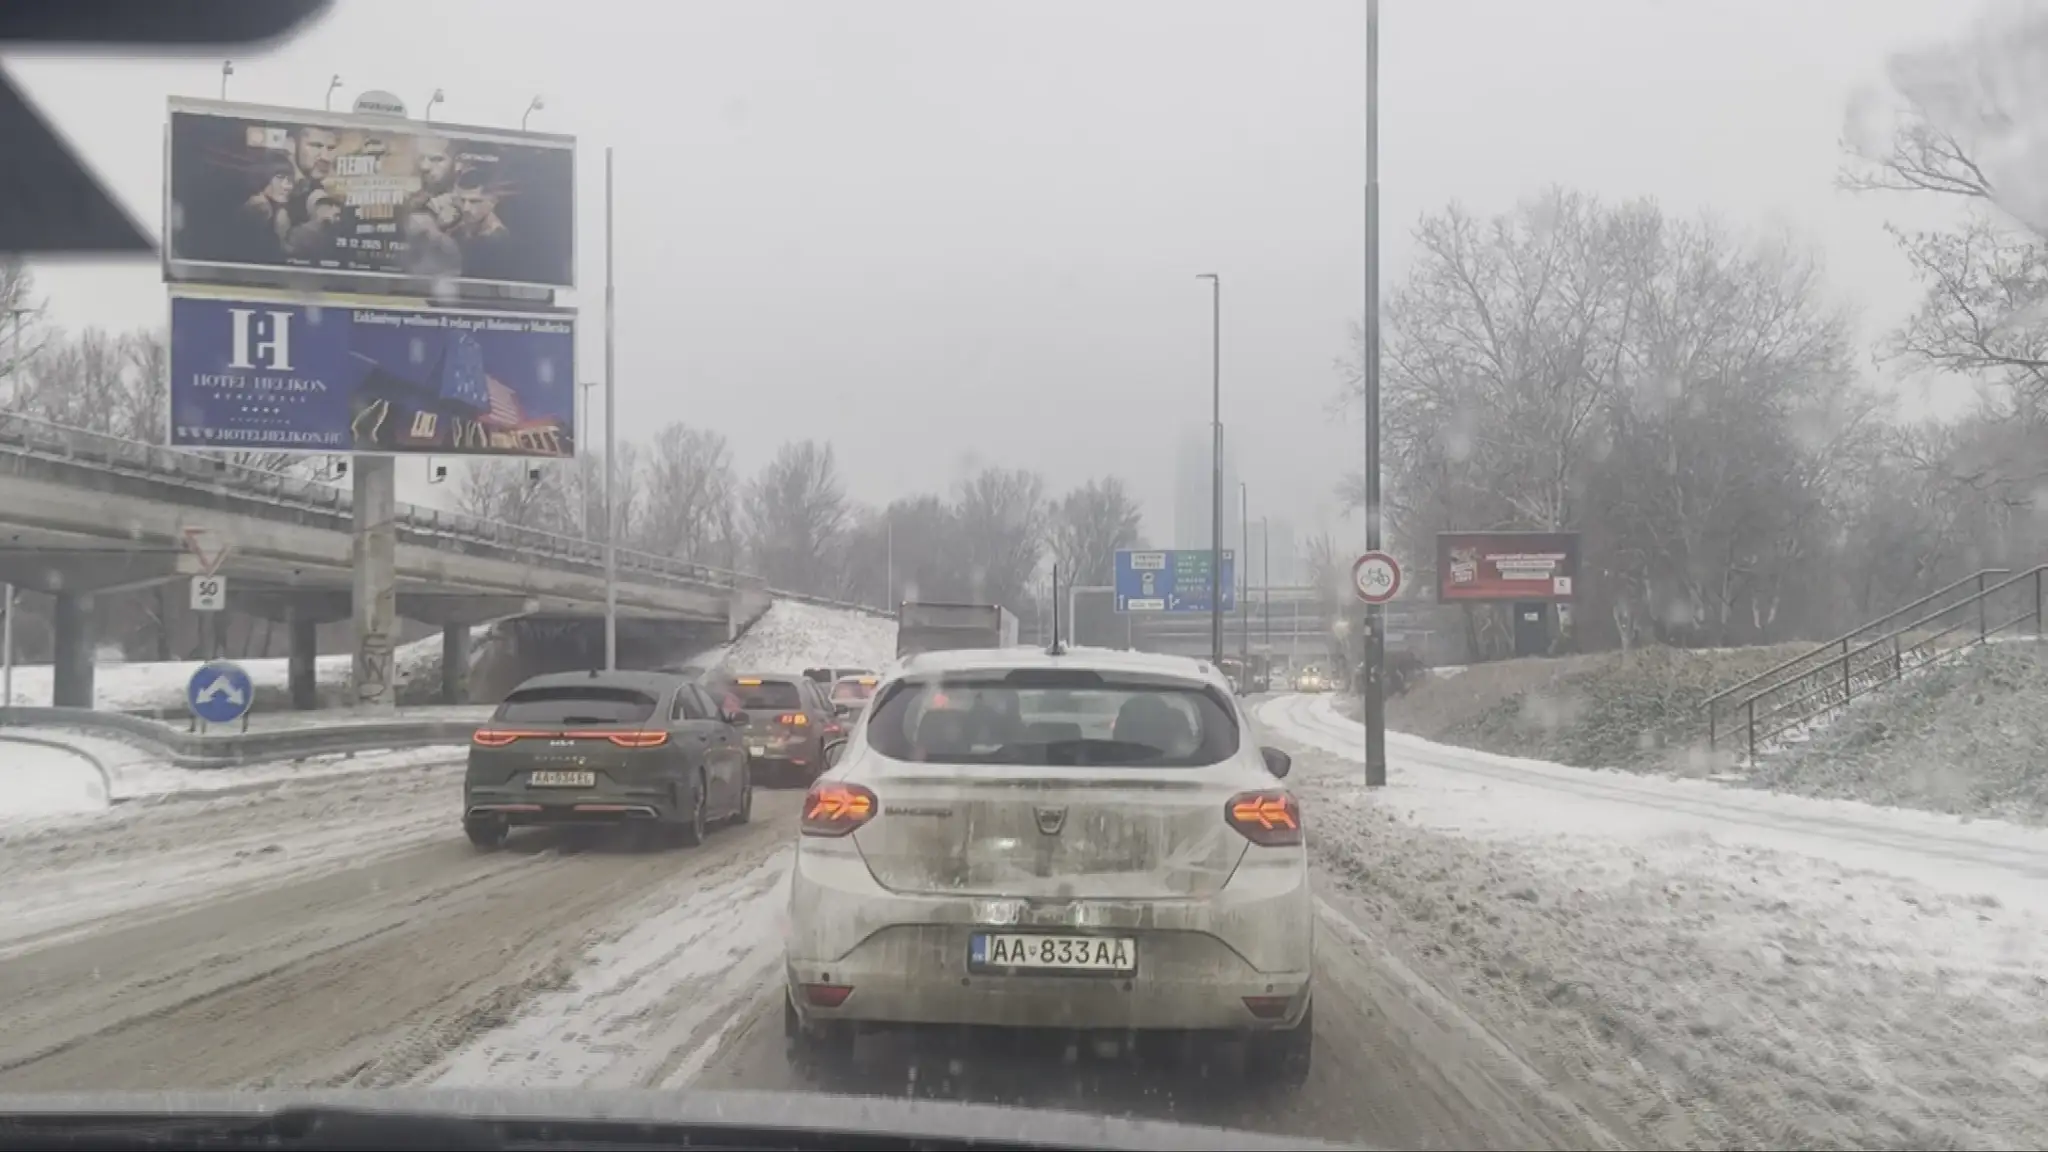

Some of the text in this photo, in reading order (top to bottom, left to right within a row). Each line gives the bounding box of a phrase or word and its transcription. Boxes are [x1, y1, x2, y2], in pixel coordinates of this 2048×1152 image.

[192, 373, 328, 393] HOTEL HELIKON
[992, 938, 1026, 963] AA
